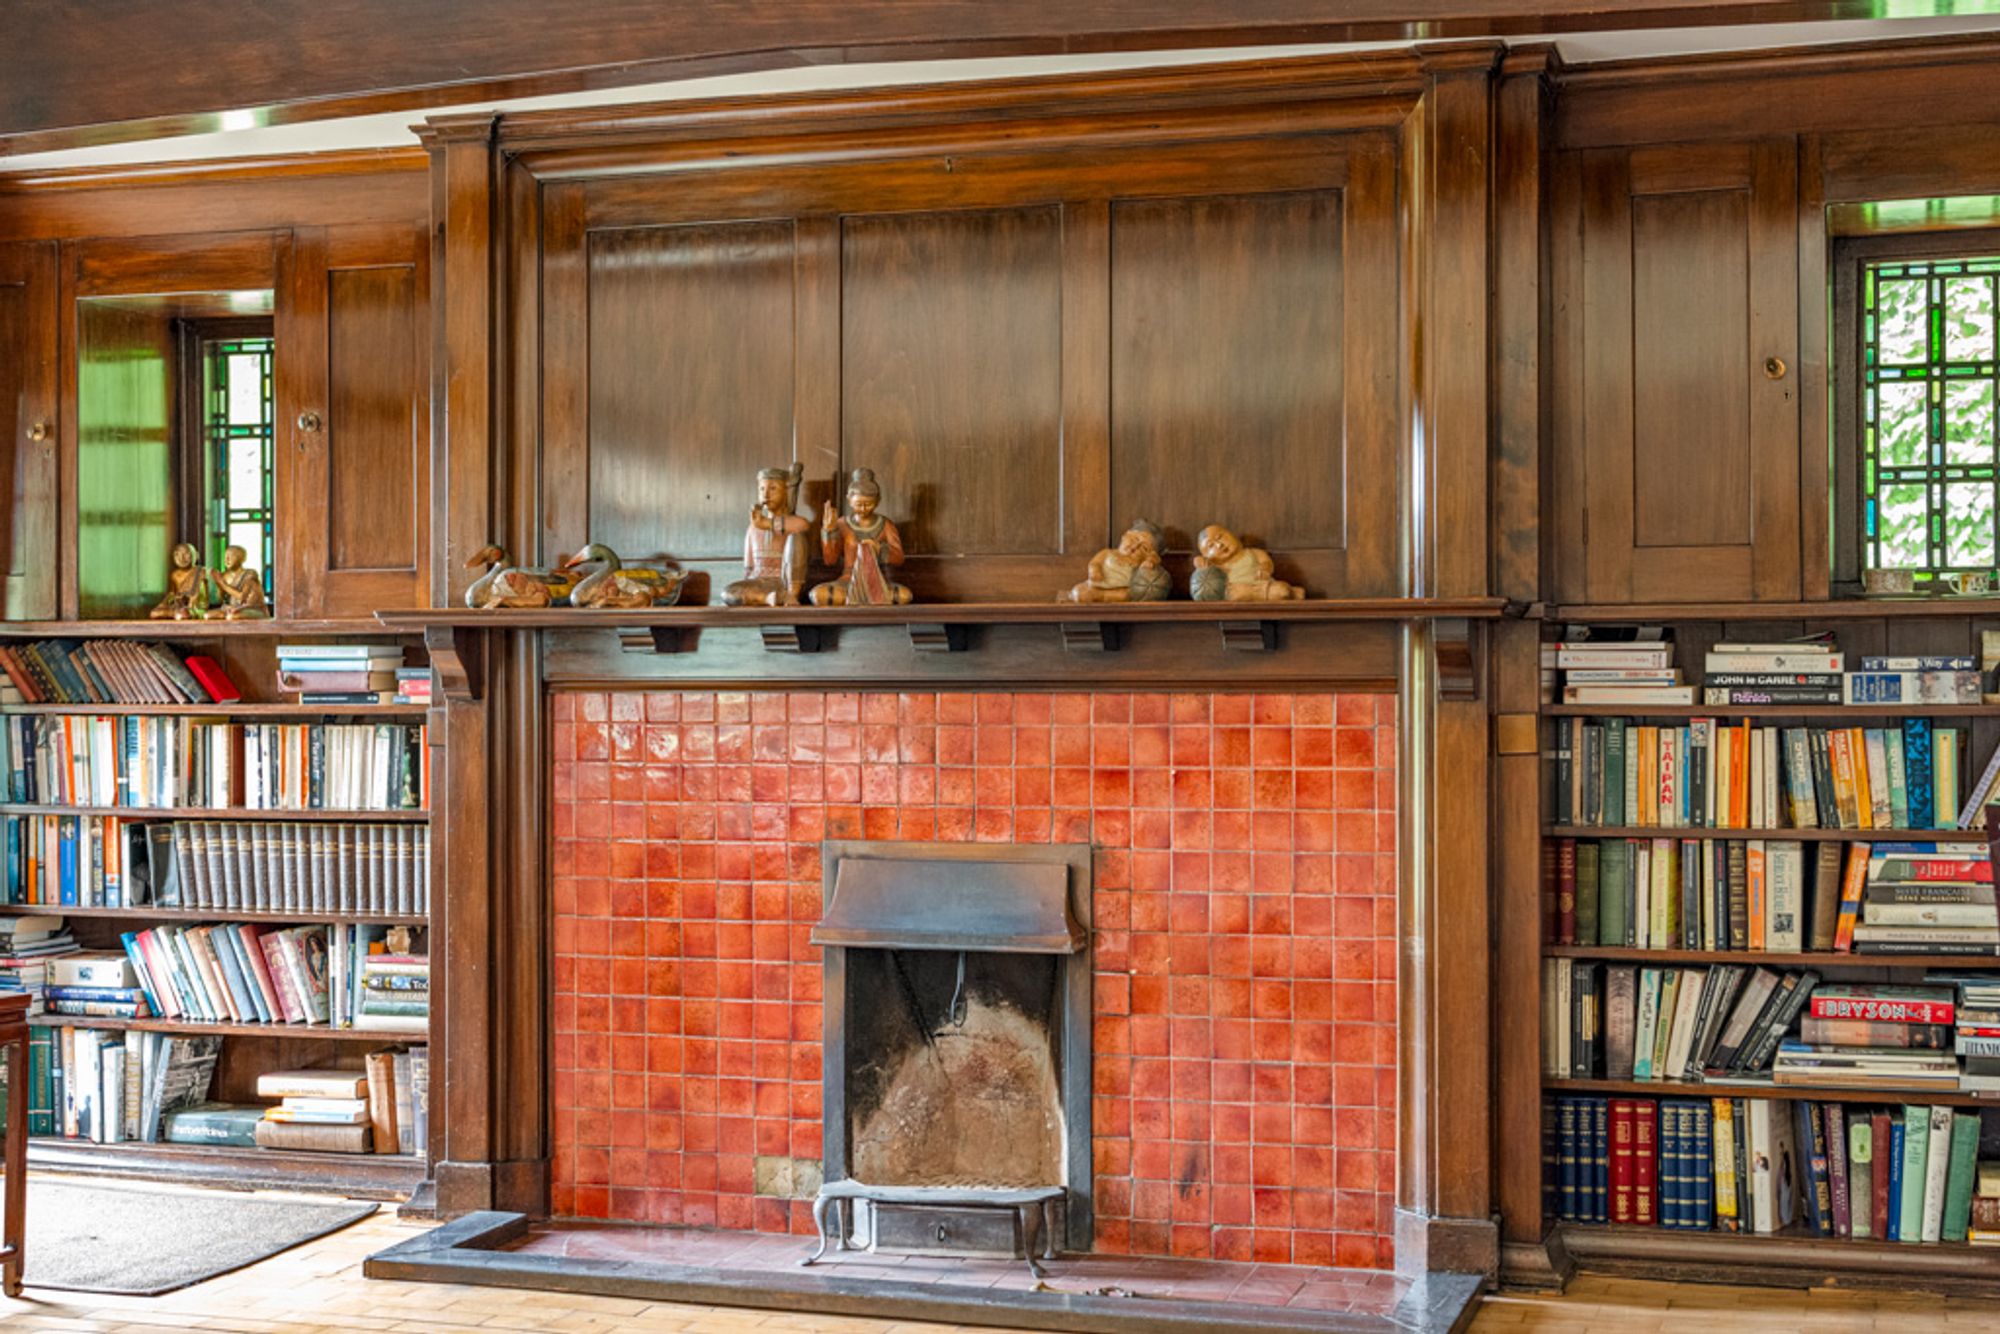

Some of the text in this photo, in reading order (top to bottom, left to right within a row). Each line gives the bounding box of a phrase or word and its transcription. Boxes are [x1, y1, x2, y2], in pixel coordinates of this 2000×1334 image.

[1713, 673, 1797, 685] JOHN le CARRÉ
[1731, 692, 1772, 703] Rankin
[1661, 740, 1674, 805] TAIPAN
[1825, 1000, 1906, 1020] BRYSON
